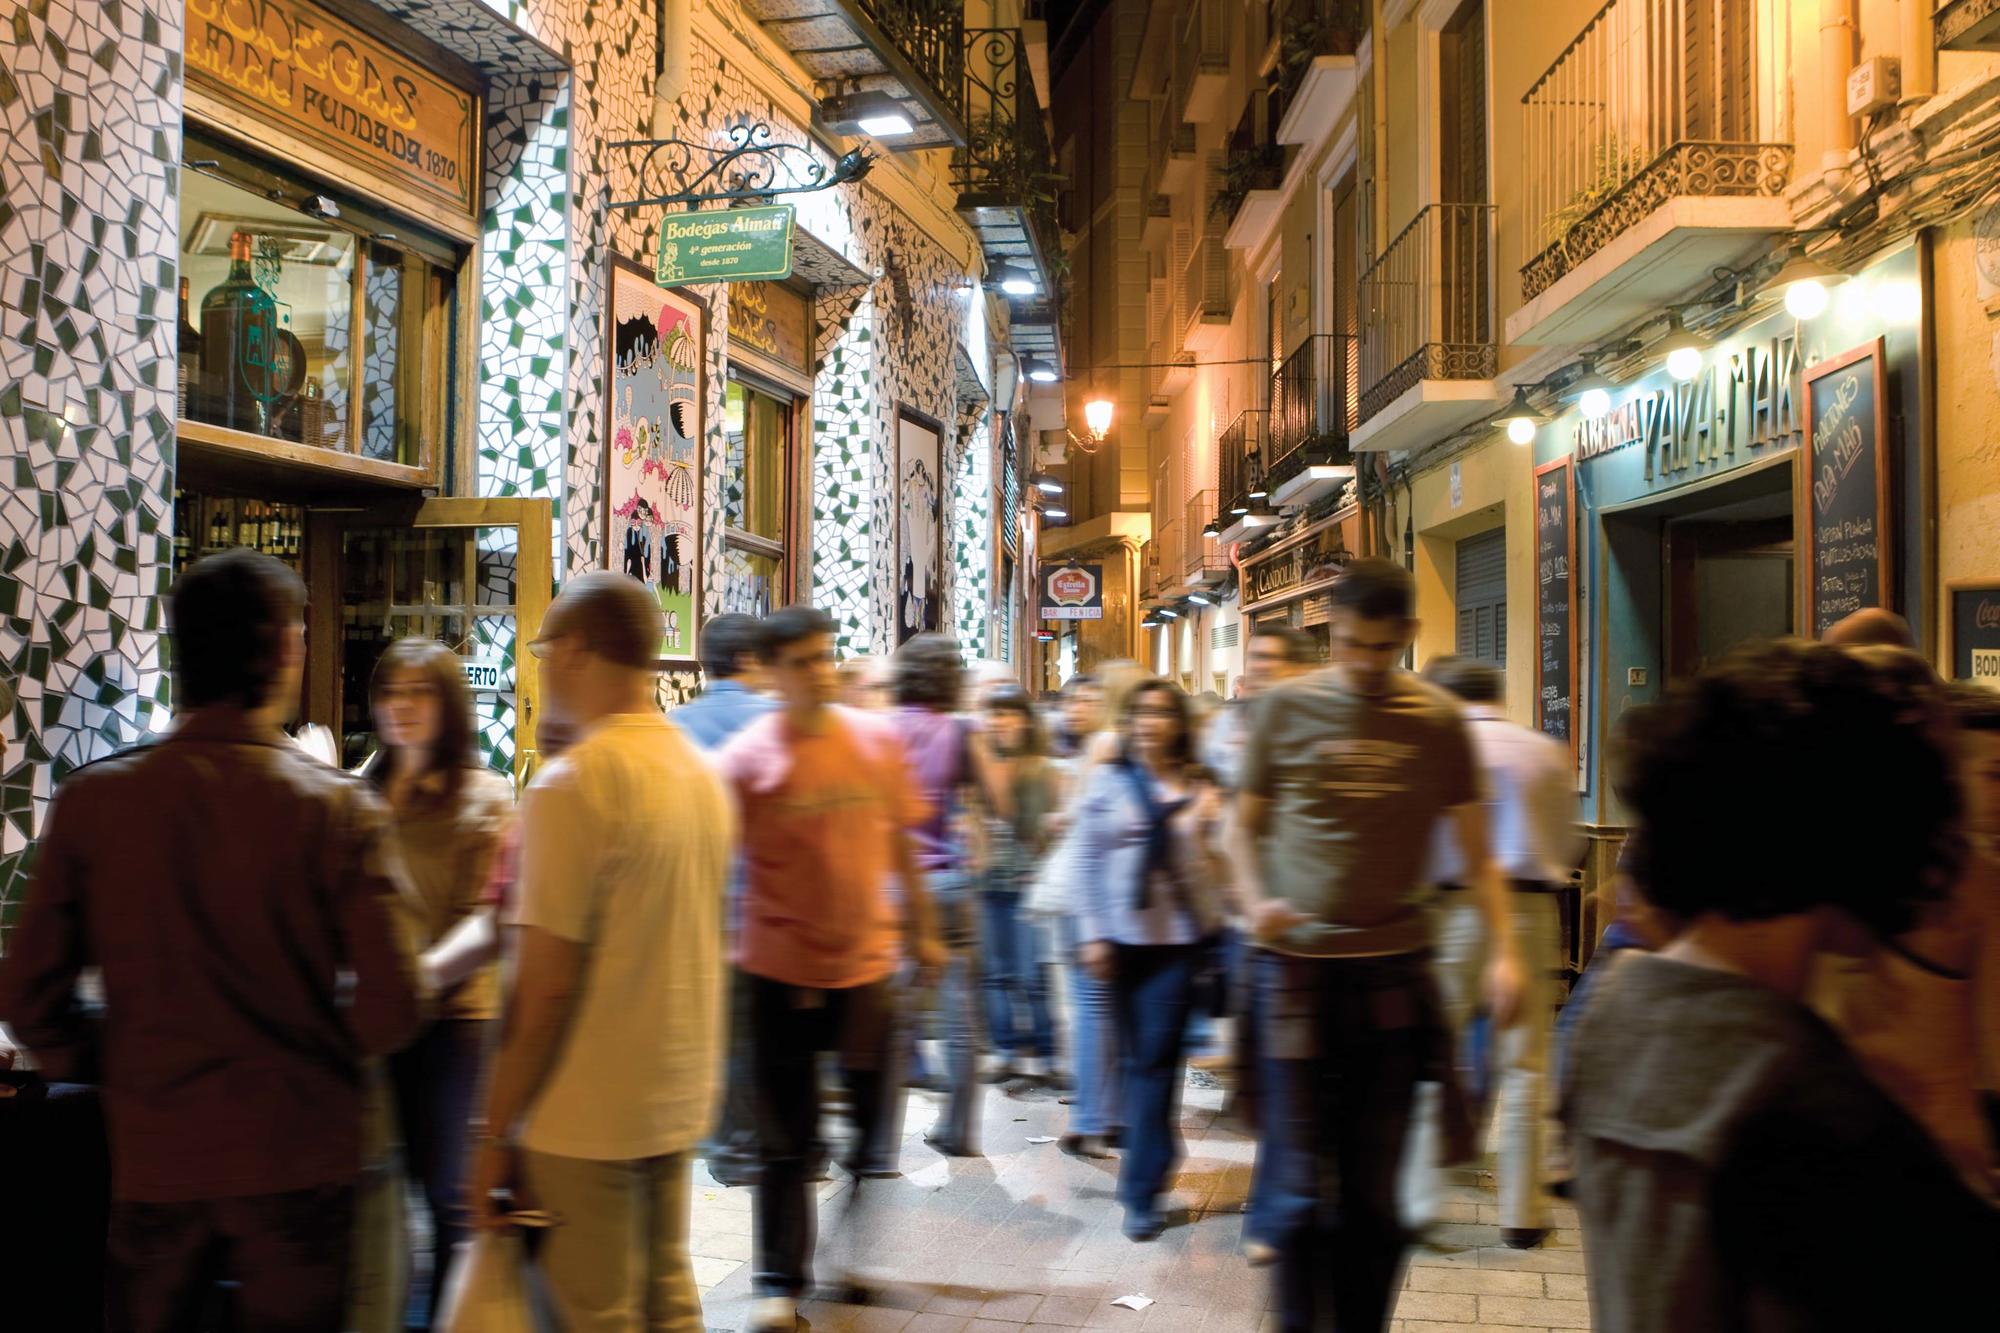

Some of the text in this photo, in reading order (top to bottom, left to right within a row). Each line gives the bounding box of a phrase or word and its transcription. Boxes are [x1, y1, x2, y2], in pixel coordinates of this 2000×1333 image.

[303, 84, 456, 181] FUNDADA 1870
[666, 221, 728, 240] Bodegas
[700, 241, 752, 256] generación
[700, 256, 739, 267] desde 1870
[1573, 399, 1643, 463] TABERNA
[1043, 607, 1101, 617] BAR FENICIA
[1975, 655, 2000, 677] BOD
